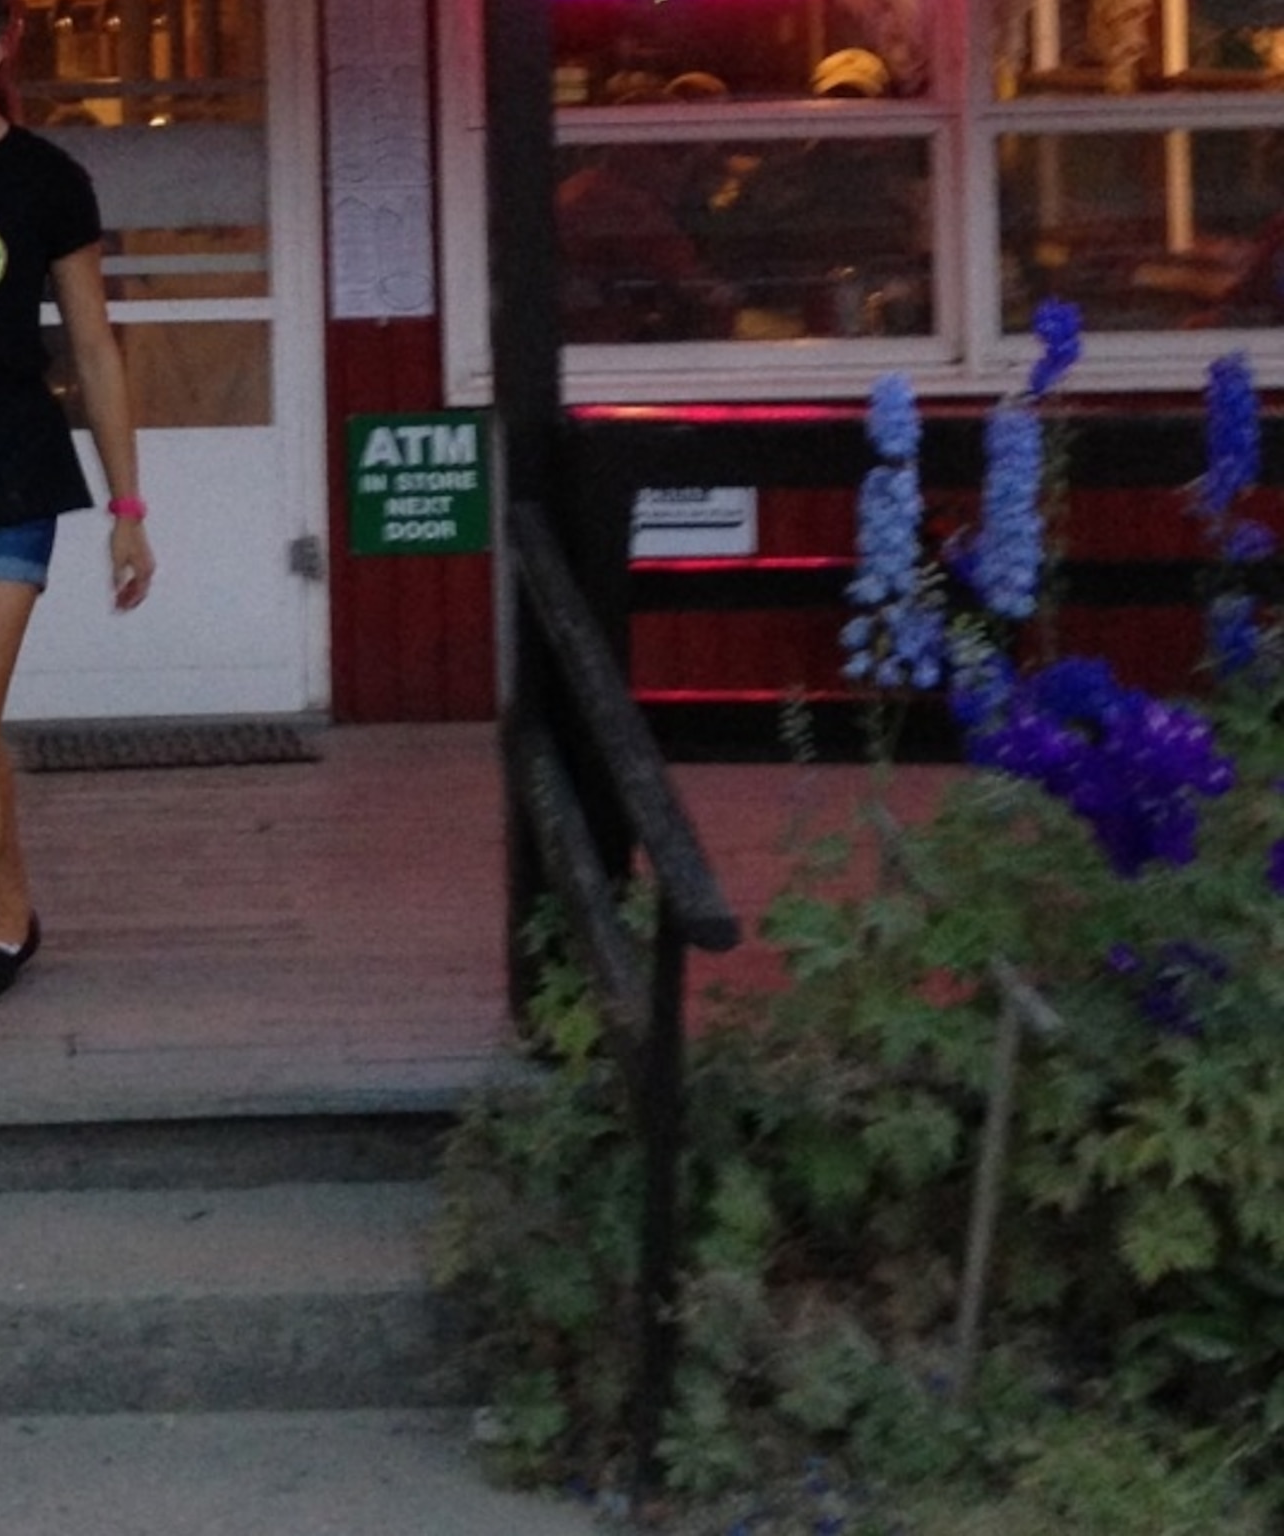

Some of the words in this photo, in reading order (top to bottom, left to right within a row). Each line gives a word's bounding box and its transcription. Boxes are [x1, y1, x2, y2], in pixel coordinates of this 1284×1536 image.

[359, 424, 477, 467] ATM
[359, 473, 388, 494] IN
[393, 470, 478, 493] STORE
[383, 496, 454, 517] NEXT
[382, 520, 458, 542] DOOR
